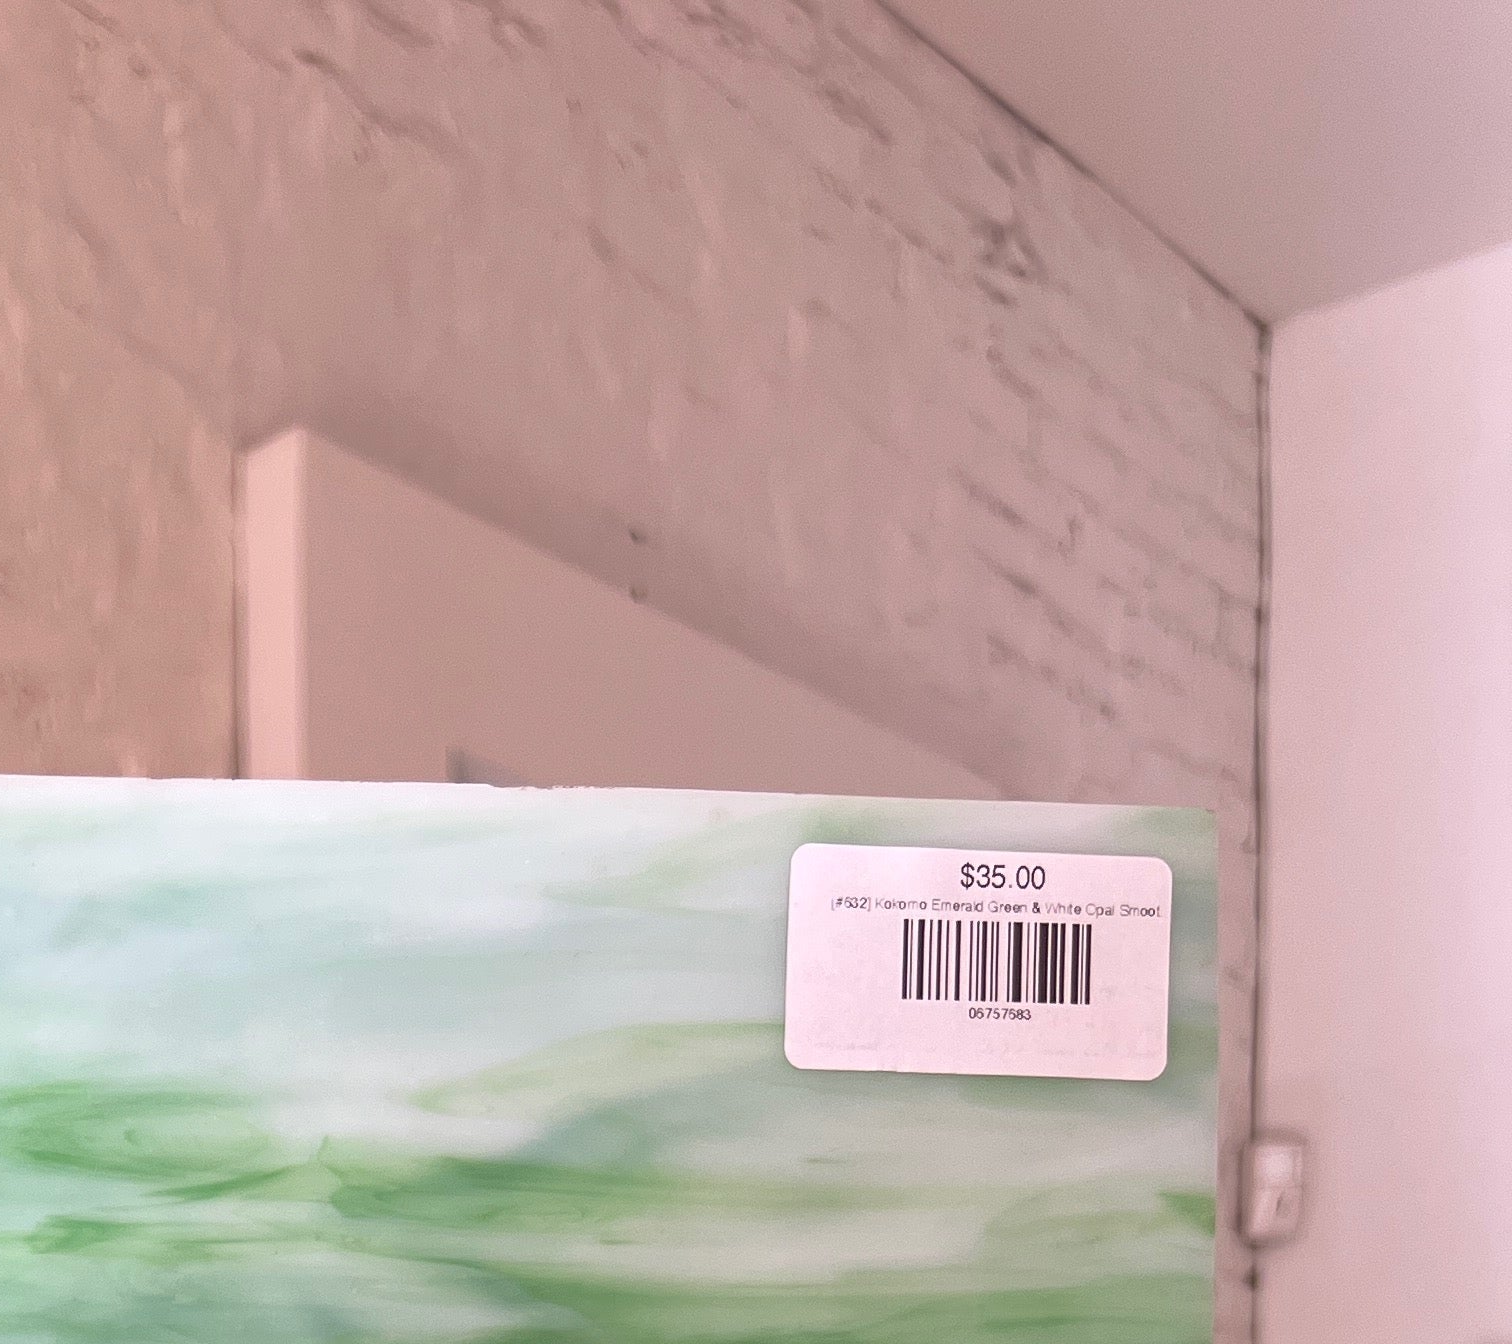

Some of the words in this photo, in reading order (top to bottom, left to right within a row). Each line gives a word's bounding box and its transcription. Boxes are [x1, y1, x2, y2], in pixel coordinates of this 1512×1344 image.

[960, 862, 1046, 890] $35.00
[875, 898, 928, 910] Kokomo
[931, 899, 984, 912] Emerald
[987, 900, 1028, 914] Green
[1032, 901, 1041, 914] &
[1044, 902, 1082, 915] White
[1085, 903, 1115, 918] Opal
